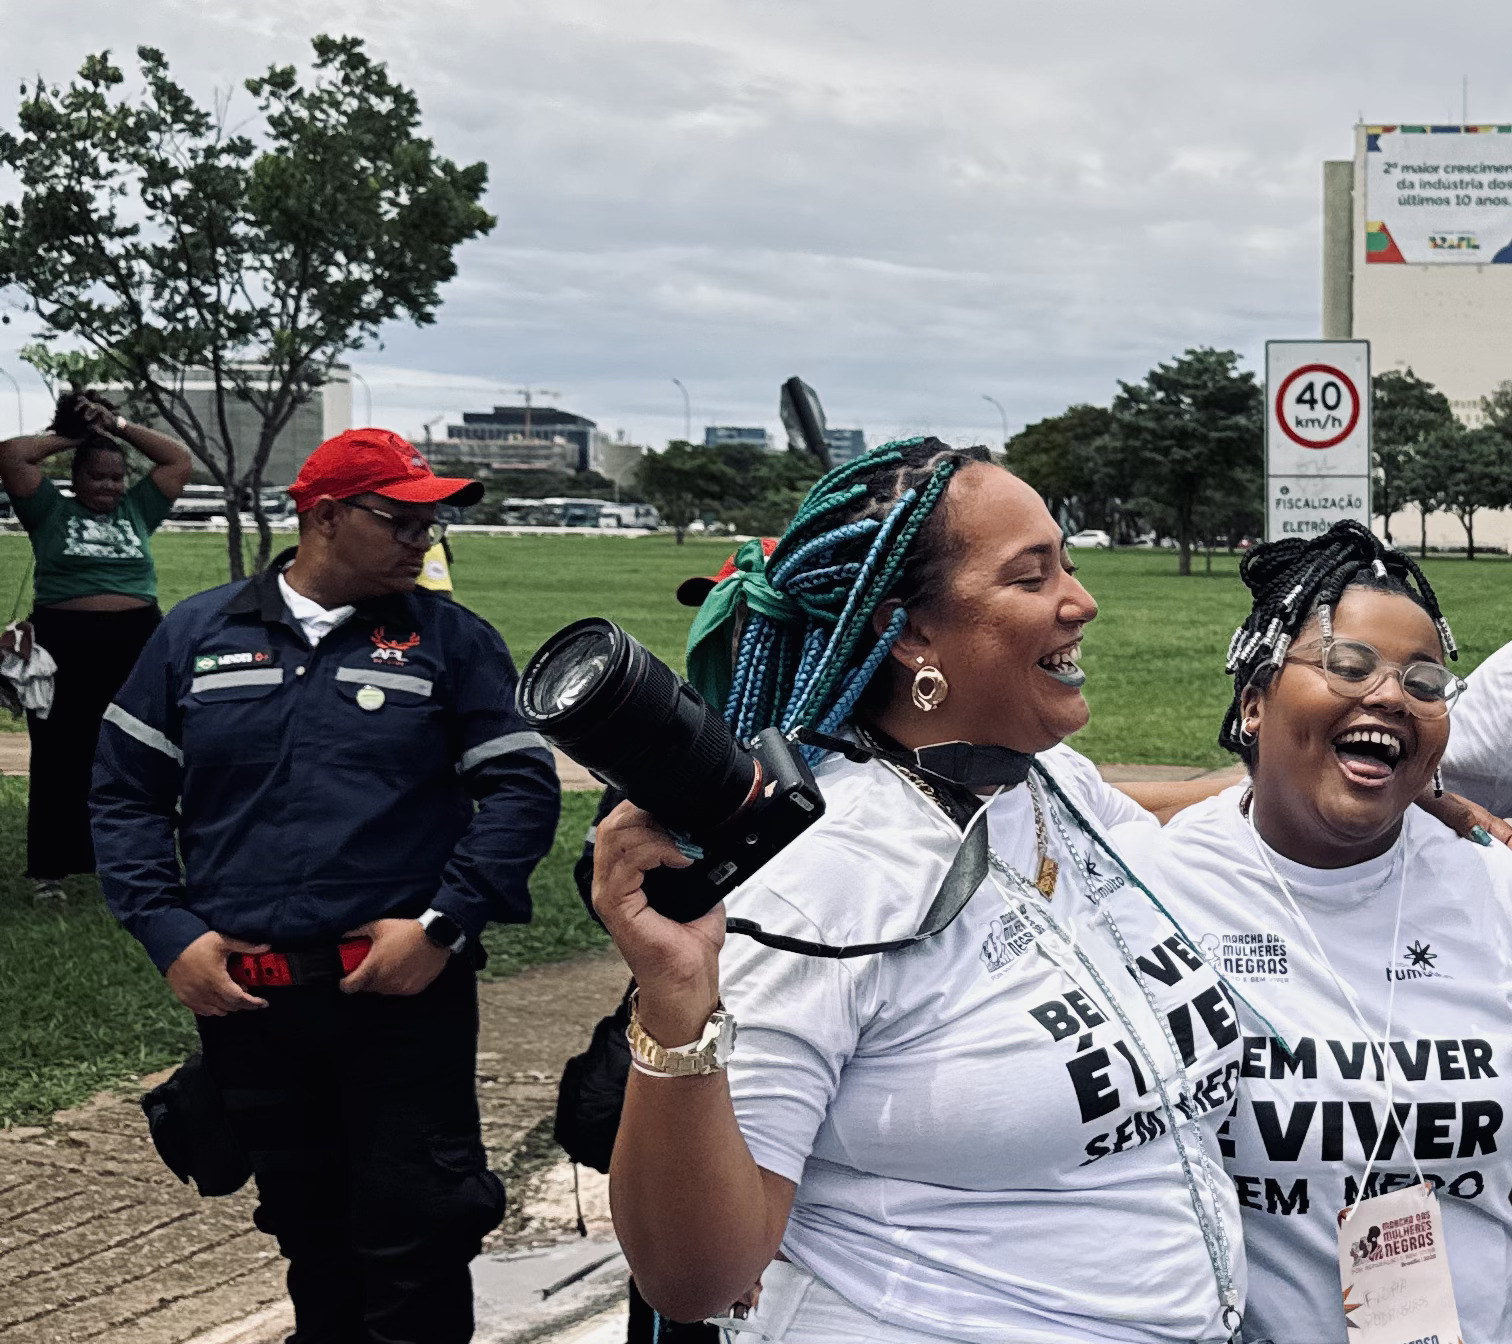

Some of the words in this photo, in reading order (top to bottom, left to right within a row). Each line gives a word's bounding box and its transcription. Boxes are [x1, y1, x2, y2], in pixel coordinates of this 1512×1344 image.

[1401, 161, 1440, 174] maior
[1397, 178, 1415, 190] da
[1419, 177, 1484, 190] indústria
[1397, 194, 1451, 206] últimos
[1455, 194, 1472, 206] 10
[1475, 196, 1512, 206] anos.
[1295, 381, 1342, 411] 40
[1295, 414, 1343, 430] km/h
[1275, 493, 1362, 512] FISCALIZAÇÃO
[1222, 933, 1264, 945] MARCHA
[1223, 944, 1287, 957] MULHERES
[1223, 957, 1288, 975] NEGRAS
[1028, 988, 1110, 1043] BE
[1240, 1036, 1318, 1080] EM
[1326, 1039, 1500, 1082] VIVER
[1065, 1032, 1121, 1125] É
[1079, 1110, 1167, 1167] SEM
[1252, 1100, 1504, 1162] VIVER
[1233, 1175, 1310, 1216] EM
[1383, 1220, 1433, 1243] MULHERES
[1385, 1232, 1435, 1257] NEGRAS
